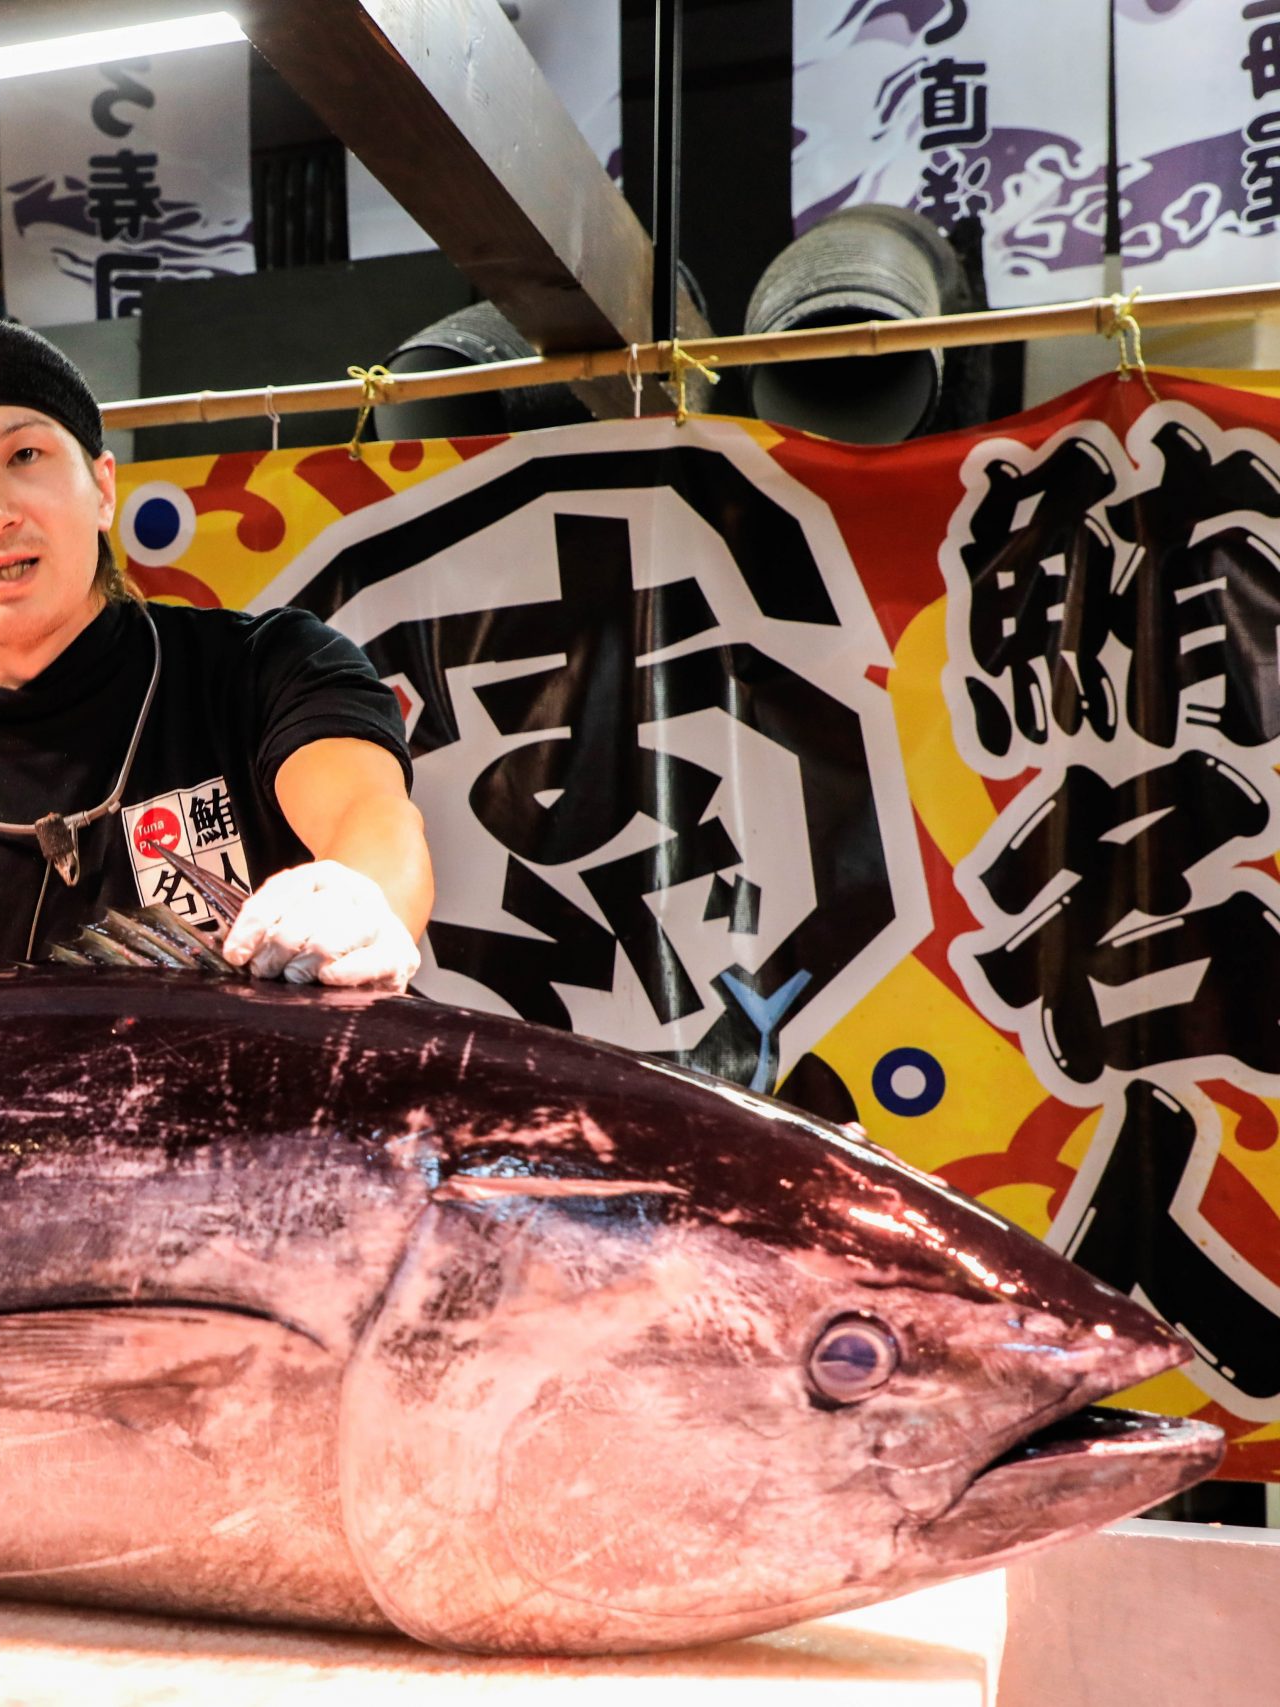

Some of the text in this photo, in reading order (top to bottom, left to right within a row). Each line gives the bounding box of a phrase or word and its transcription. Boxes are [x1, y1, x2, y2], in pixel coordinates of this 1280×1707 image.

[137, 819, 165, 836] Tuna
[189, 788, 240, 847] 鮪
[960, 421, 1280, 1397] 鮪名人
